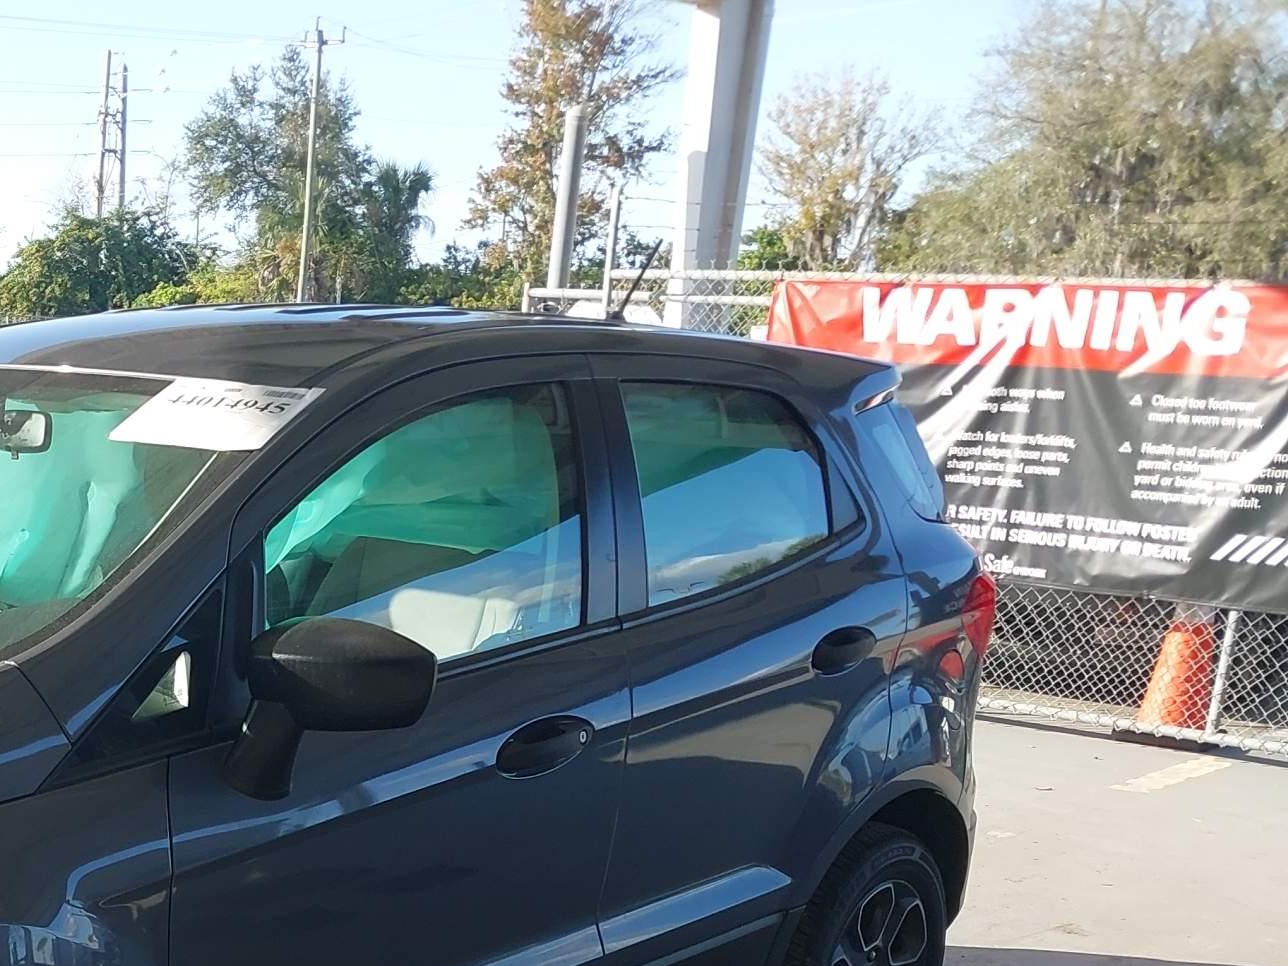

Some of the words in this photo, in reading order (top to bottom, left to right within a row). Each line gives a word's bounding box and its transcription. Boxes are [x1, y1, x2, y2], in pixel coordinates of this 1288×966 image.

[863, 284, 1252, 356] WARNING
[168, 395, 292, 414] 44014945
[1152, 394, 1187, 409] Closed
[1207, 398, 1258, 413] footwear
[1148, 412, 1175, 424] must
[1176, 412, 1190, 424] be
[1192, 415, 1220, 427] worn
[1221, 417, 1235, 428] on
[985, 431, 1000, 442] for
[947, 445, 982, 457] jagged
[1014, 448, 1040, 460] loose
[1141, 442, 1176, 456] Health
[1176, 446, 1197, 457] and
[1197, 447, 1232, 462] safety
[947, 459, 974, 471] sharp
[975, 460, 1005, 472] points
[1024, 465, 1061, 476] uneven
[1137, 460, 1171, 472] permit
[944, 473, 981, 487] walking
[1134, 474, 1160, 486] yard
[1161, 477, 1173, 486] or
[1244, 484, 1273, 495] even
[1275, 482, 1286, 496] if
[1230, 497, 1261, 510] adult.
[957, 504, 1008, 523] SAFETY.
[1010, 509, 1065, 527] FAILURE
[1066, 513, 1084, 530] TO
[1085, 515, 1141, 537] FOLLOW
[952, 522, 991, 540] SULT
[990, 526, 1007, 541] IN
[1008, 528, 1066, 548] SERIOUS
[1067, 533, 1120, 554] INJURY
[1120, 539, 1142, 557] OR
[984, 553, 1013, 574] Safe
